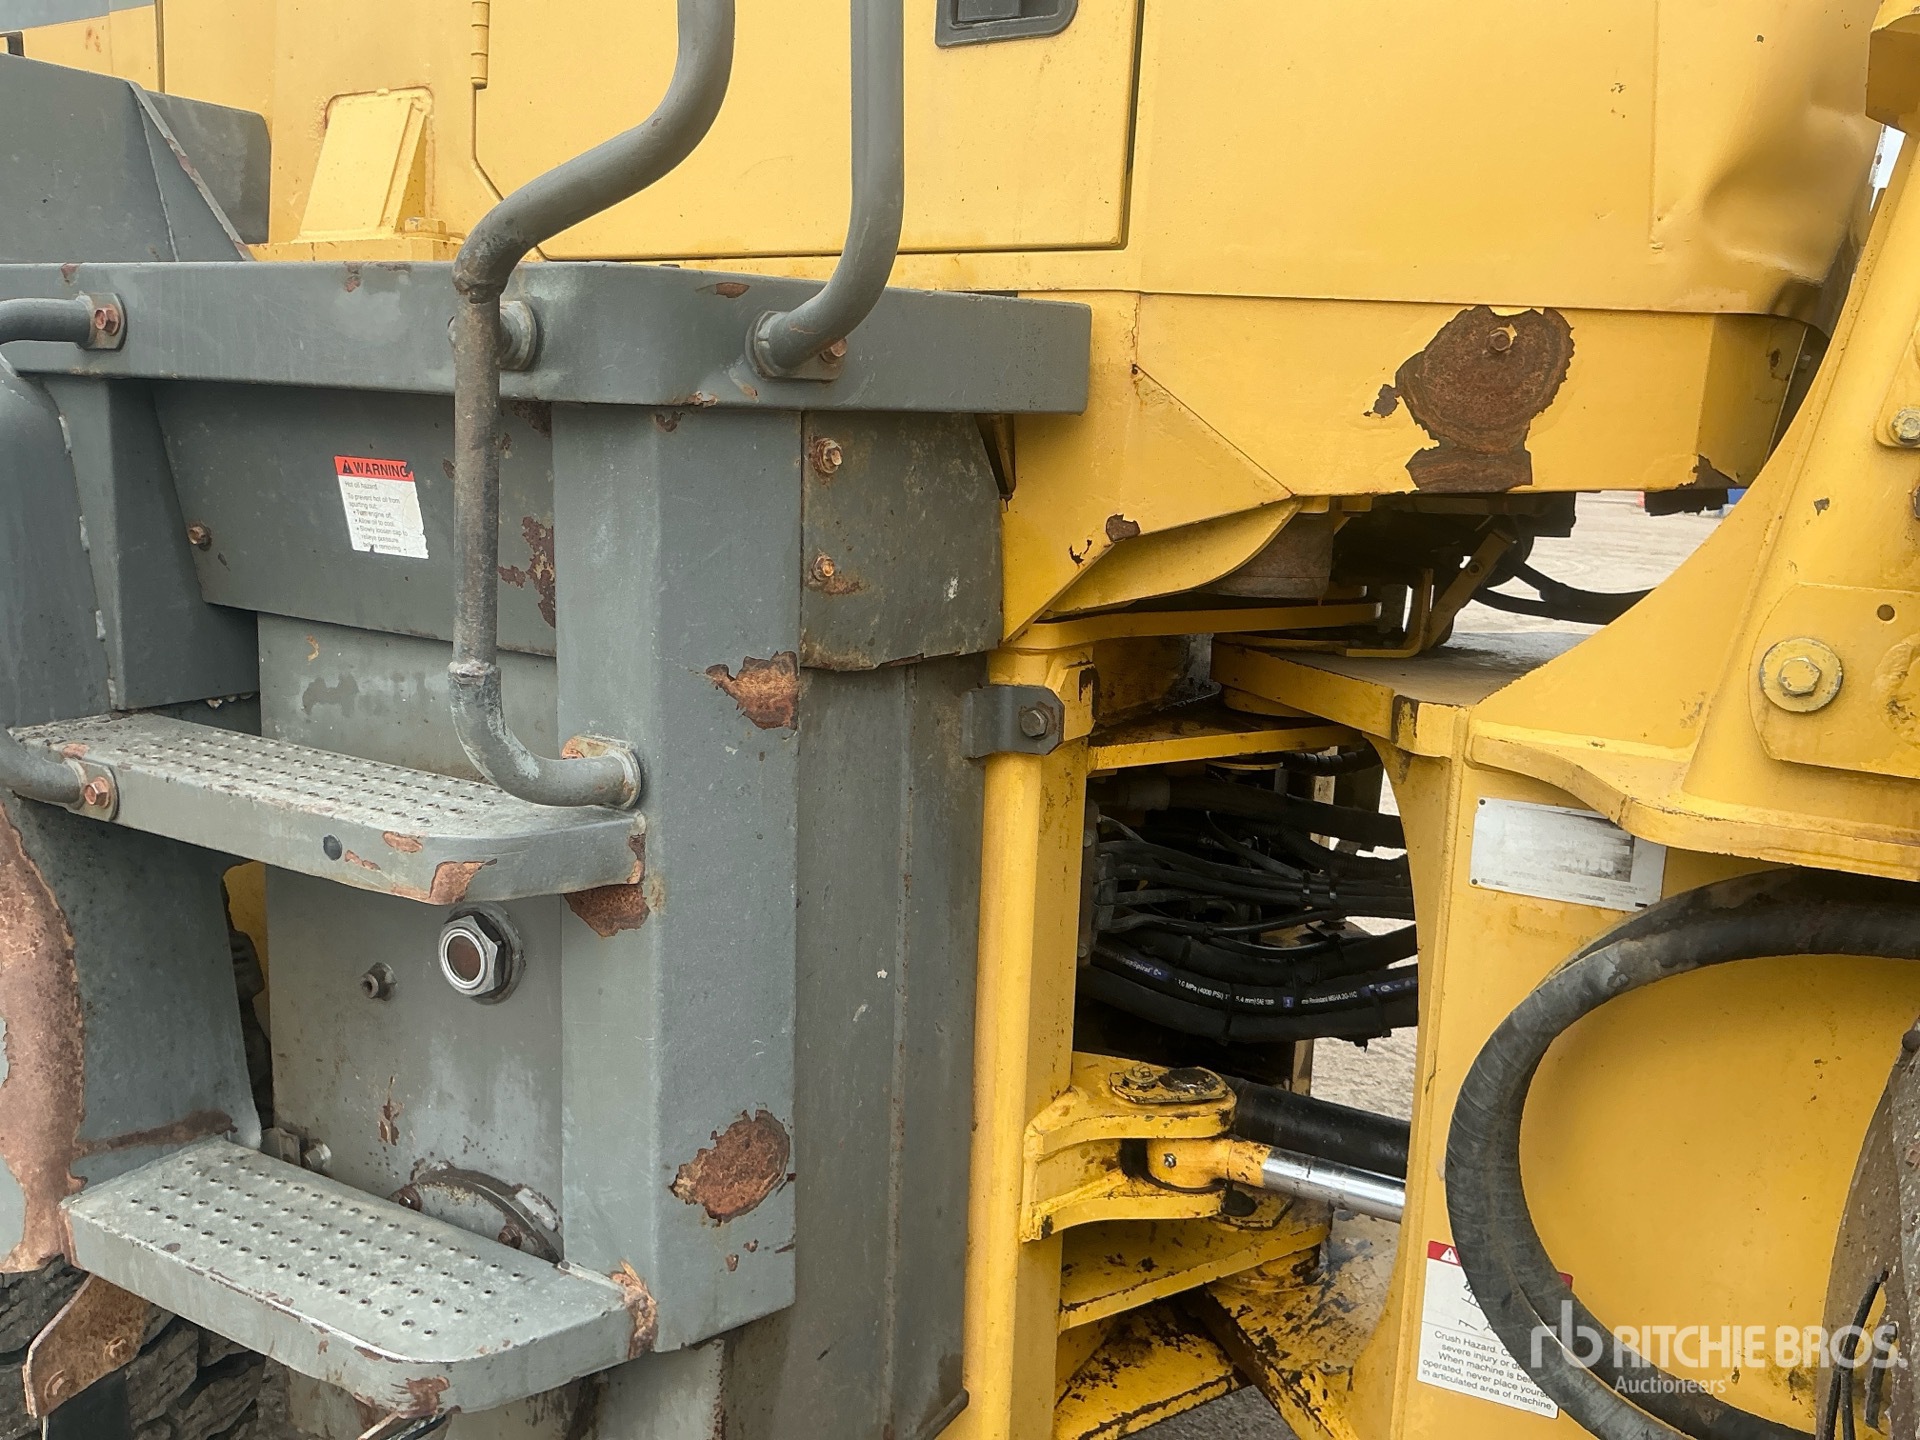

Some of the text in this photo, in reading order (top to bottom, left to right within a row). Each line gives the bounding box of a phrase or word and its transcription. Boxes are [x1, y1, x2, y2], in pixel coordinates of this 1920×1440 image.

[1434, 1330, 1461, 1344] Crush
[1464, 1338, 1498, 1354] Hazard.
[1438, 1351, 1464, 1365] When
[1466, 1361, 1504, 1376] machine
[1507, 1370, 1514, 1379] is
[1442, 1344, 1471, 1357] severe
[1473, 1353, 1498, 1365] injury
[1432, 1372, 1478, 1389] articulated
[1480, 1383, 1500, 1396] area
[1514, 1394, 1554, 1411] machine.
[1466, 1371, 1491, 1382] never
[1494, 1378, 1518, 1390] place
